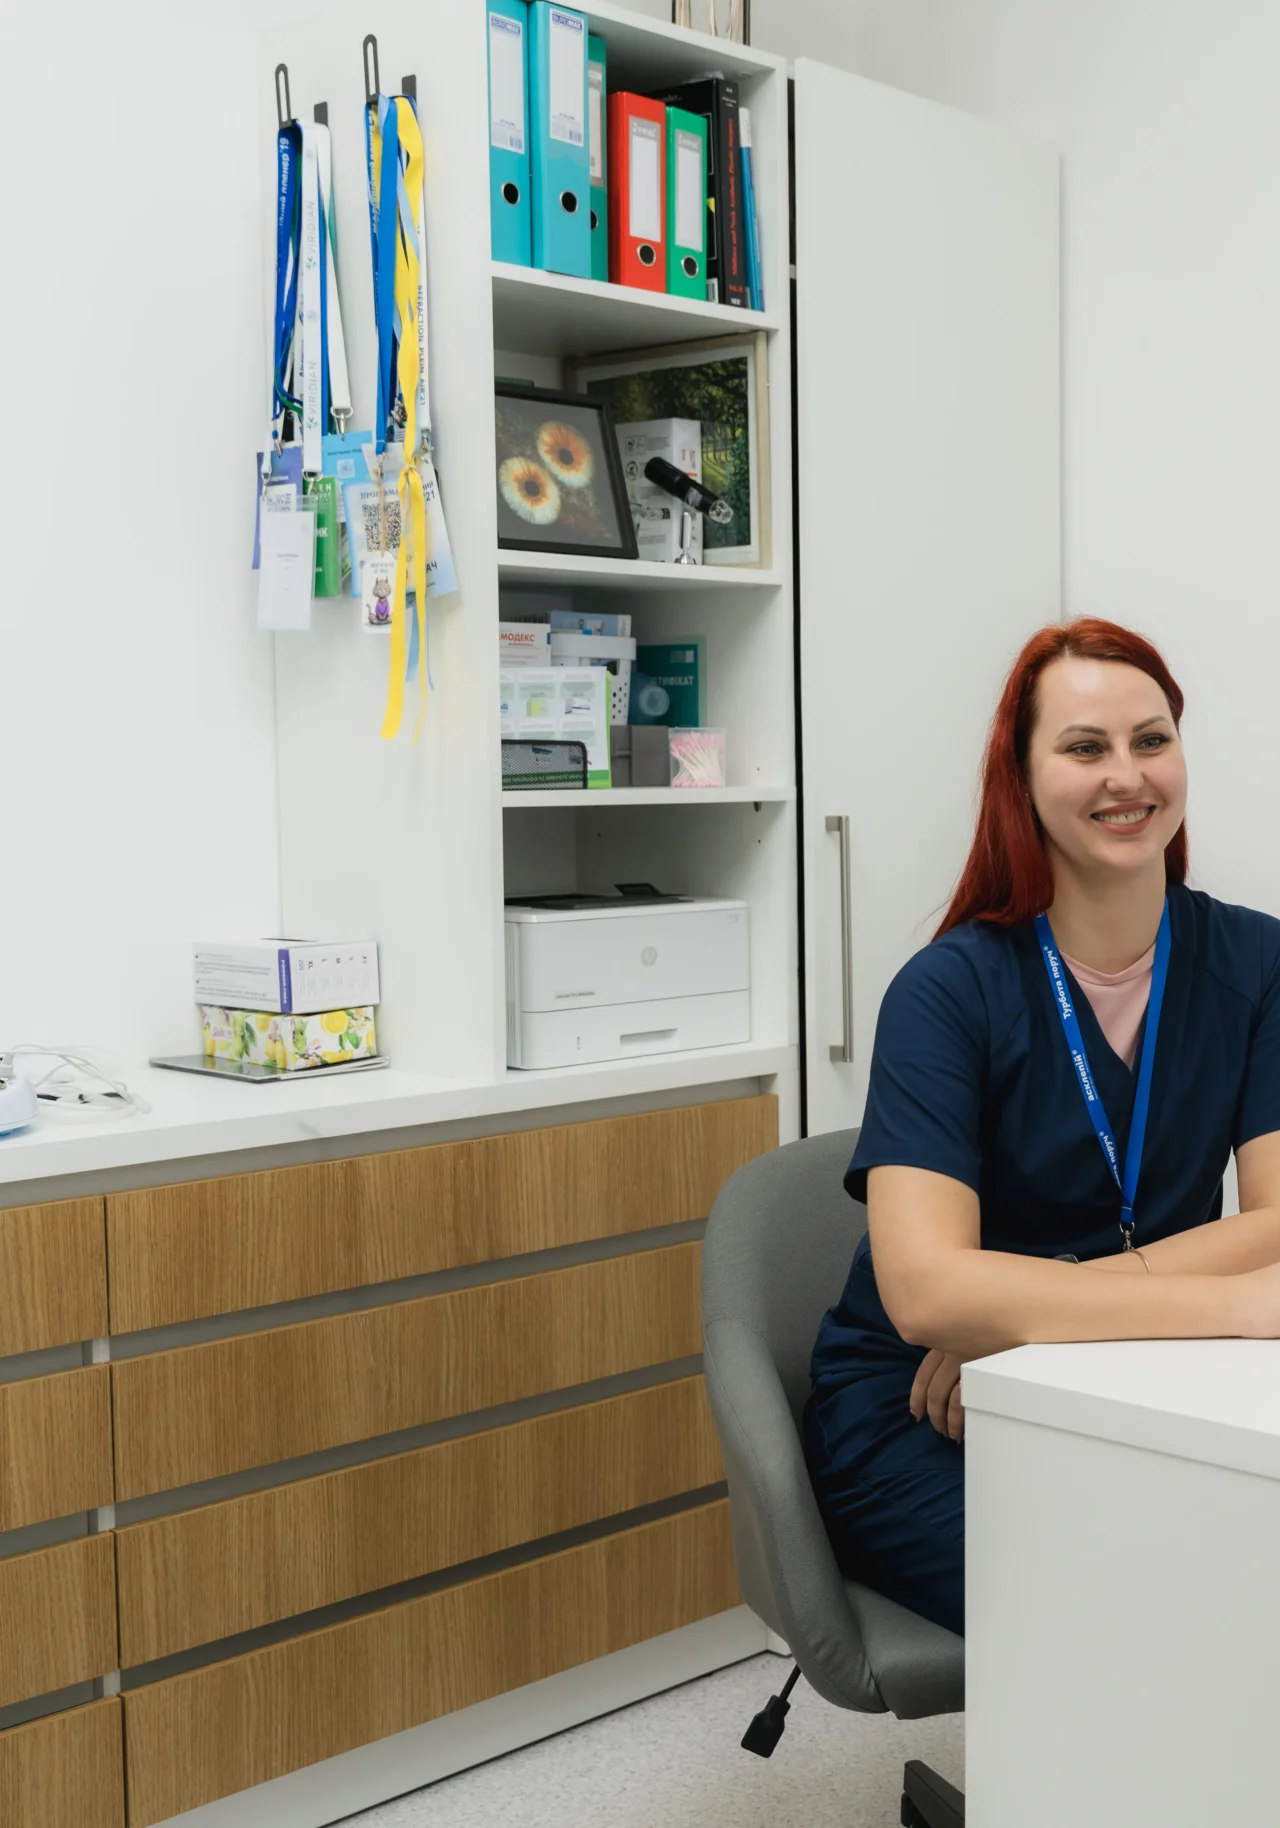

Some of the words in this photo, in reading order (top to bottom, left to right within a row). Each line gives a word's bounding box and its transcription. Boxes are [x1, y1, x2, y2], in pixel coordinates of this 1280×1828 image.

[307, 201, 315, 255] VIRIDIAN
[309, 361, 318, 413] VIRIDIAN
[500, 633, 535, 642] МОДЕКС
[1055, 980, 1073, 1020] Турбота
